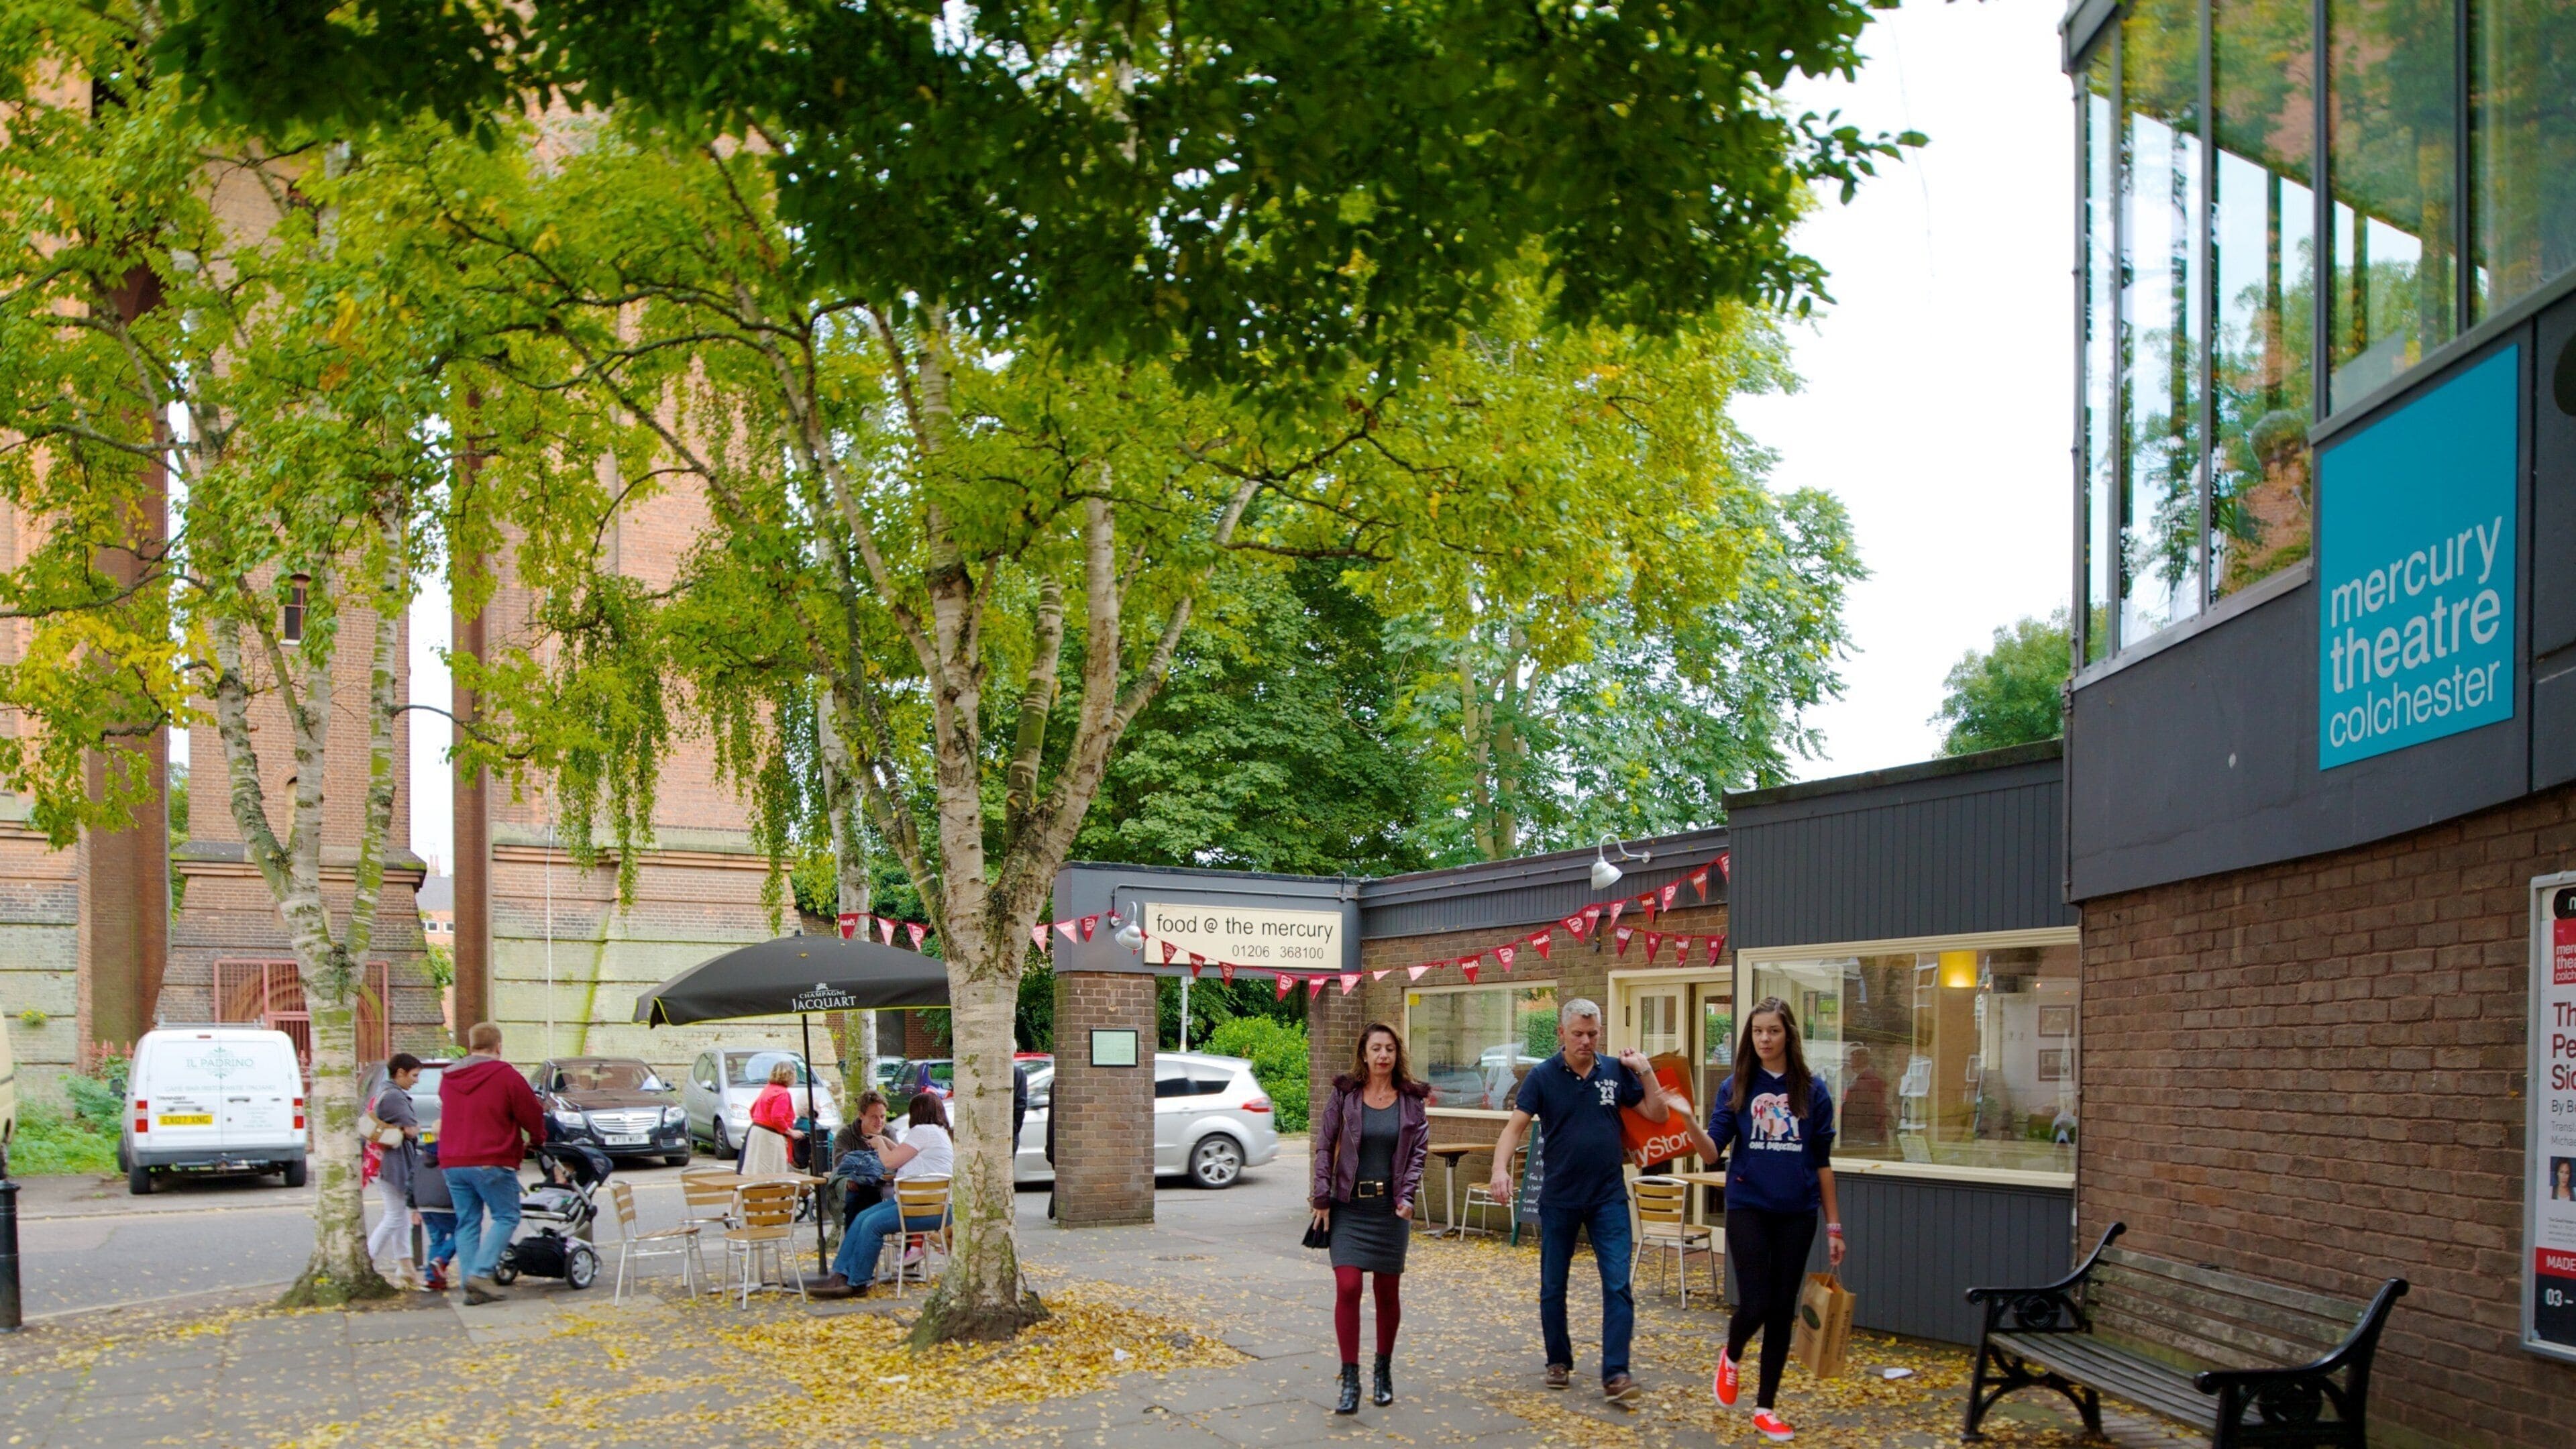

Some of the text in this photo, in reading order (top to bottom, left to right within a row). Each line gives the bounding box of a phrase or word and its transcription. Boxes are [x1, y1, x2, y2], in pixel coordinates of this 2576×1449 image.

[2331, 516, 2502, 628] mercury
[2330, 588, 2501, 694] theatre
[2330, 660, 2500, 748] colchester
[1157, 914, 1334, 944] food @ the mercury
[1232, 945, 1324, 959] 01206 368100
[799, 989, 846, 999] CHAMPAGNE
[792, 996, 857, 1012] JACQUART
[186, 1058, 254, 1068] IL PADRINO
[1600, 1086, 1615, 1099] 23
[2552, 1099, 2565, 1116] By
[1749, 1141, 1803, 1152] ONE DIRECTION
[2546, 1254, 2576, 1272] MADE
[2546, 1287, 2563, 1307] 03
